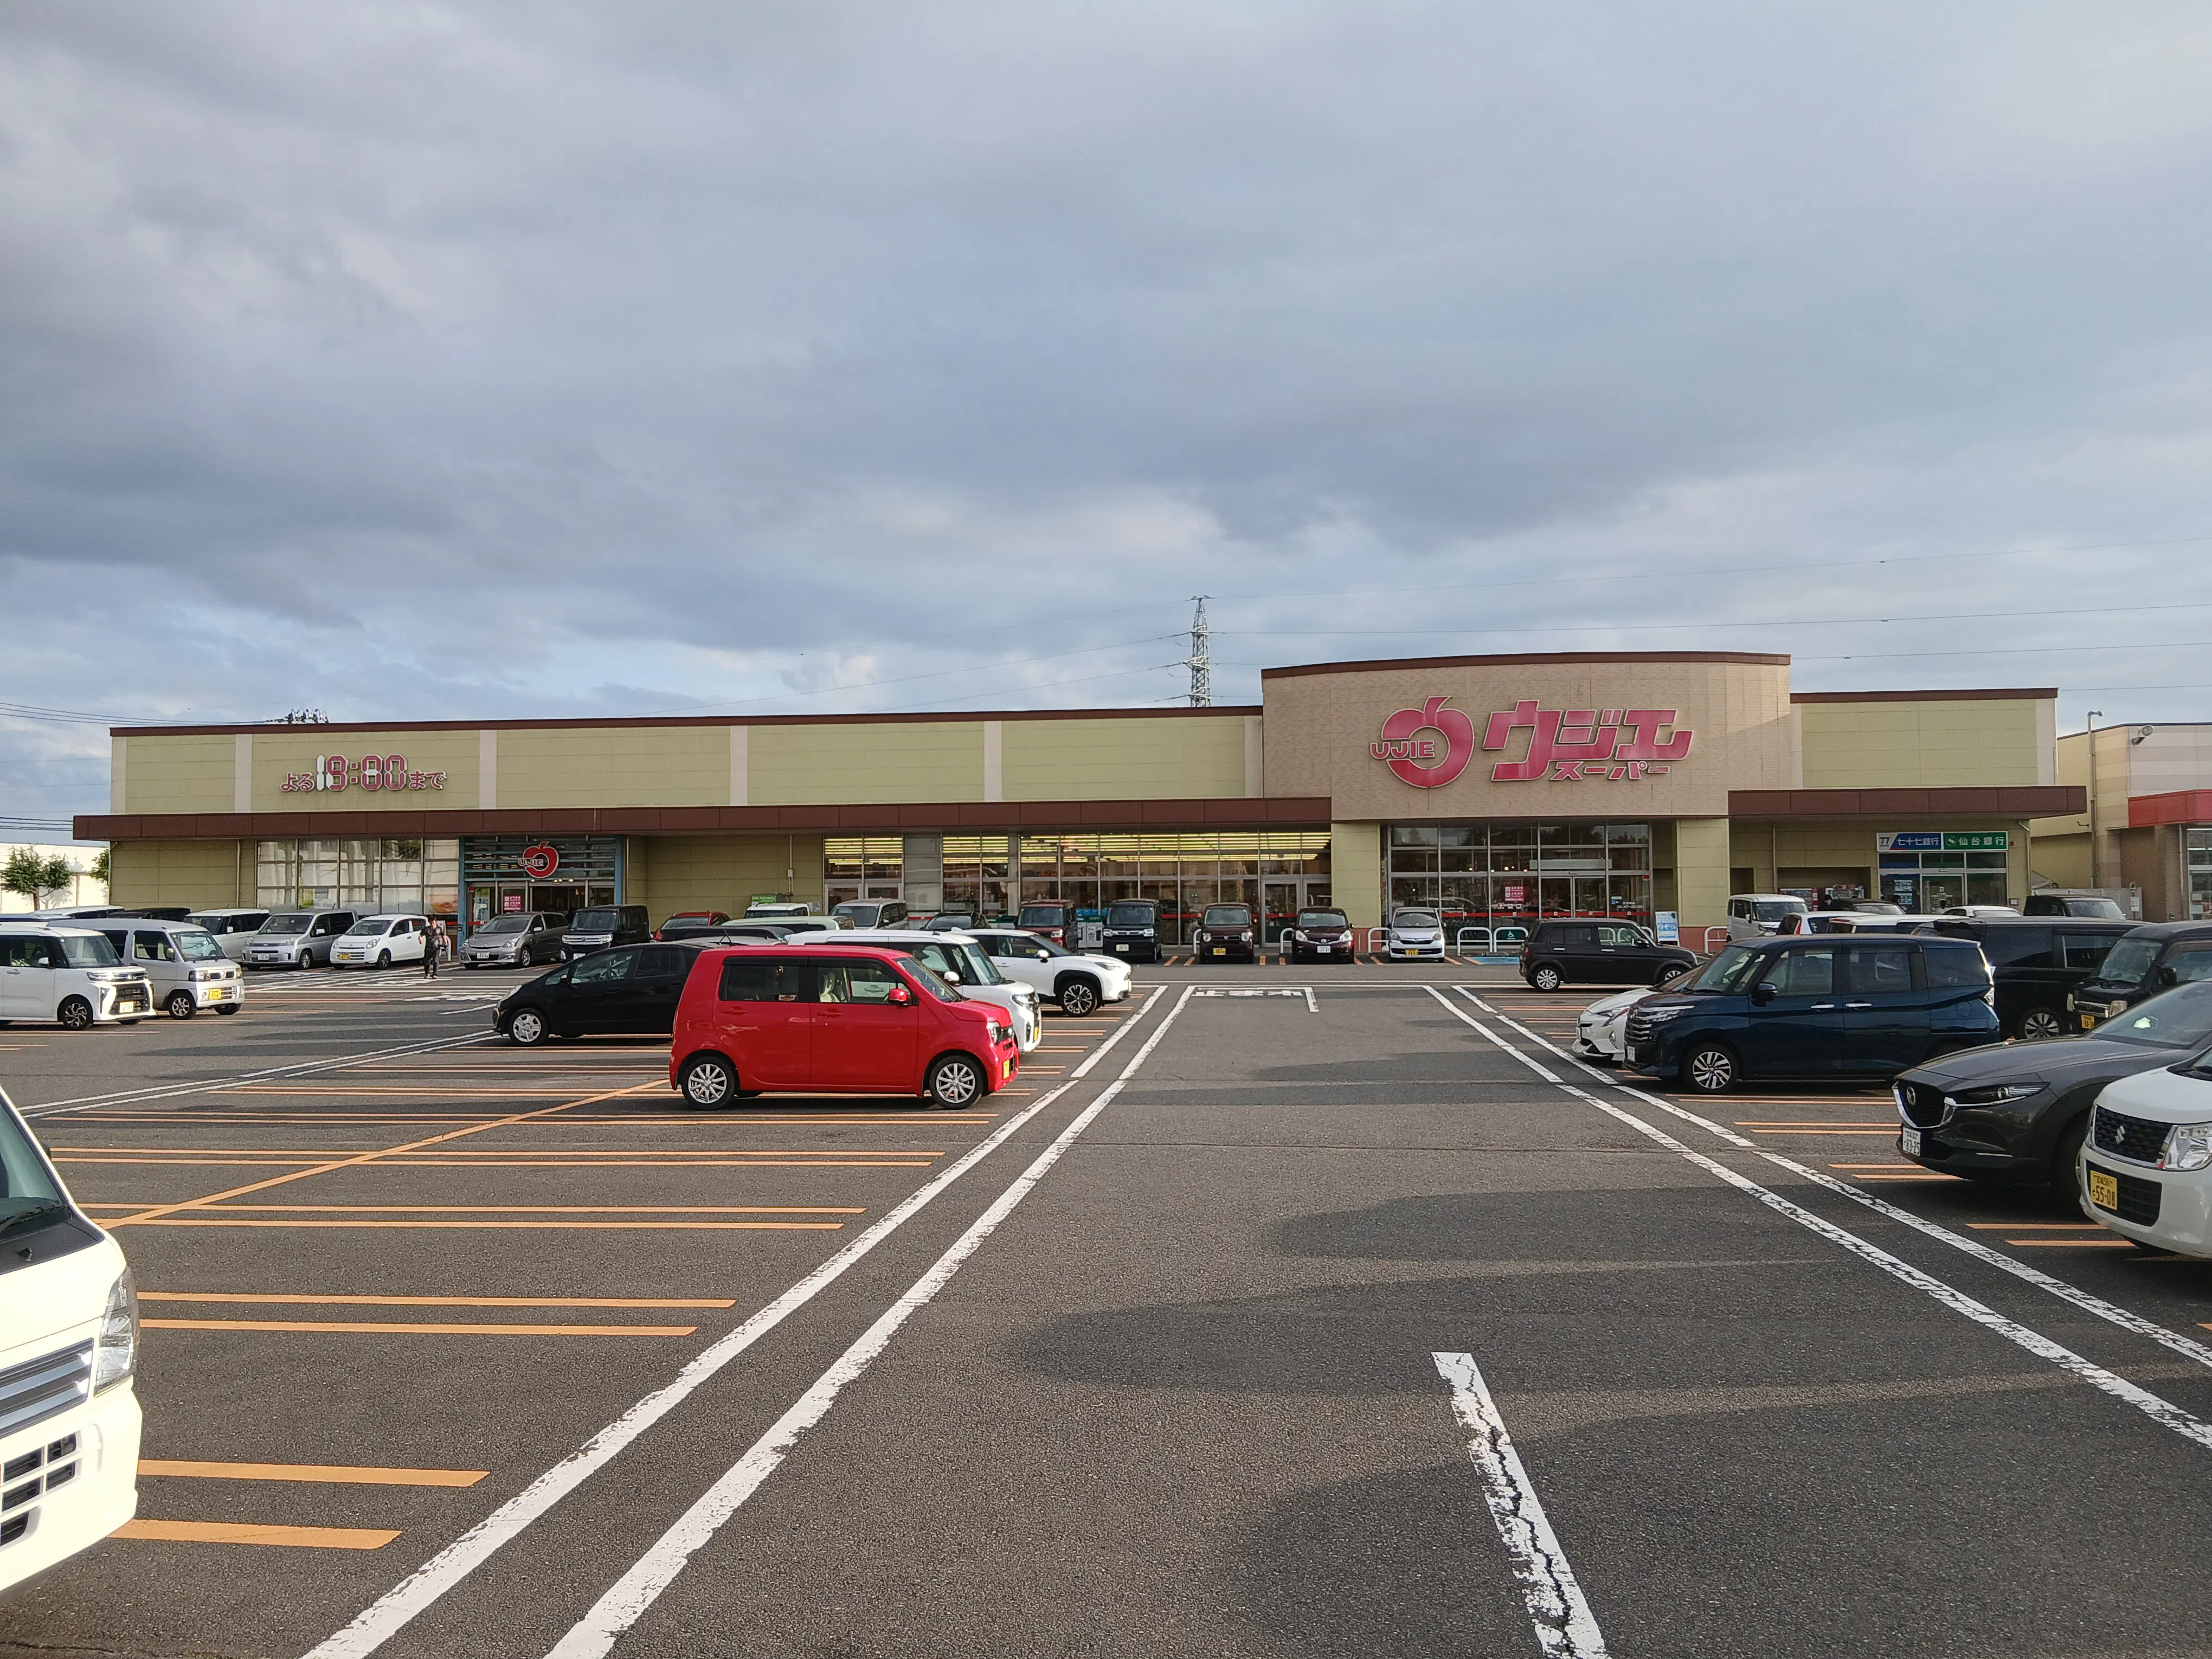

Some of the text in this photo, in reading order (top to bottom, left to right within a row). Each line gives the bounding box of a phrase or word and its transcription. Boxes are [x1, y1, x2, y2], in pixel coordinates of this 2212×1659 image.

[1370, 740, 1435, 759] UJIE
[1483, 699, 1694, 781] ウジエ
[1549, 761, 1670, 781] スーパー
[1898, 836, 1939, 846] 七十七銀行
[1958, 836, 2005, 846] 仙台銀行
[2095, 1185, 2115, 1207] 55-08
